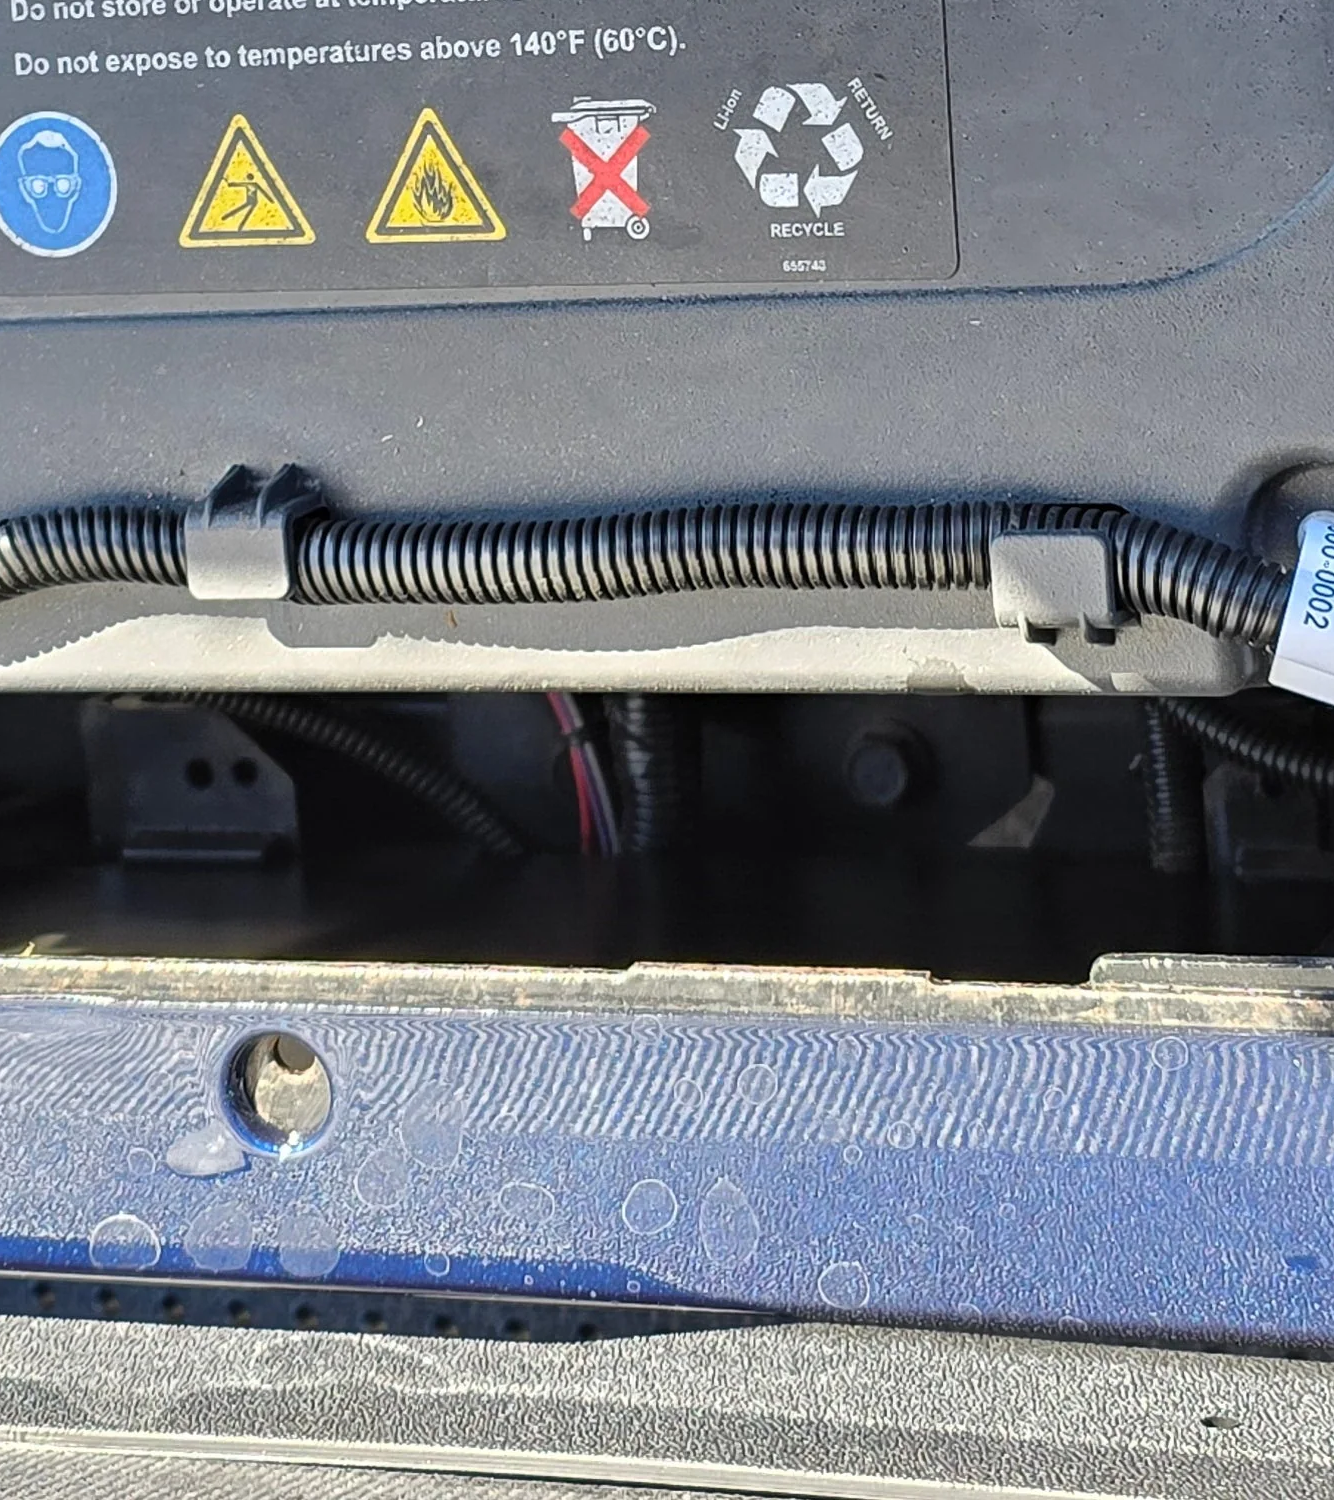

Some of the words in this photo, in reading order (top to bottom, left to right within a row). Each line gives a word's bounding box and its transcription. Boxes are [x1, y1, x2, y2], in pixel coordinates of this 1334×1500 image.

[14, 50, 50, 76] Do
[55, 48, 99, 74] not
[104, 48, 199, 77] expose
[204, 43, 231, 69] to
[236, 37, 412, 72] temperatures
[419, 32, 501, 60] above
[508, 29, 586, 57] 140°F
[592, 24, 687, 60] (60°C).
[848, 77, 893, 141] RETURN
[771, 222, 845, 237] RECYCLE
